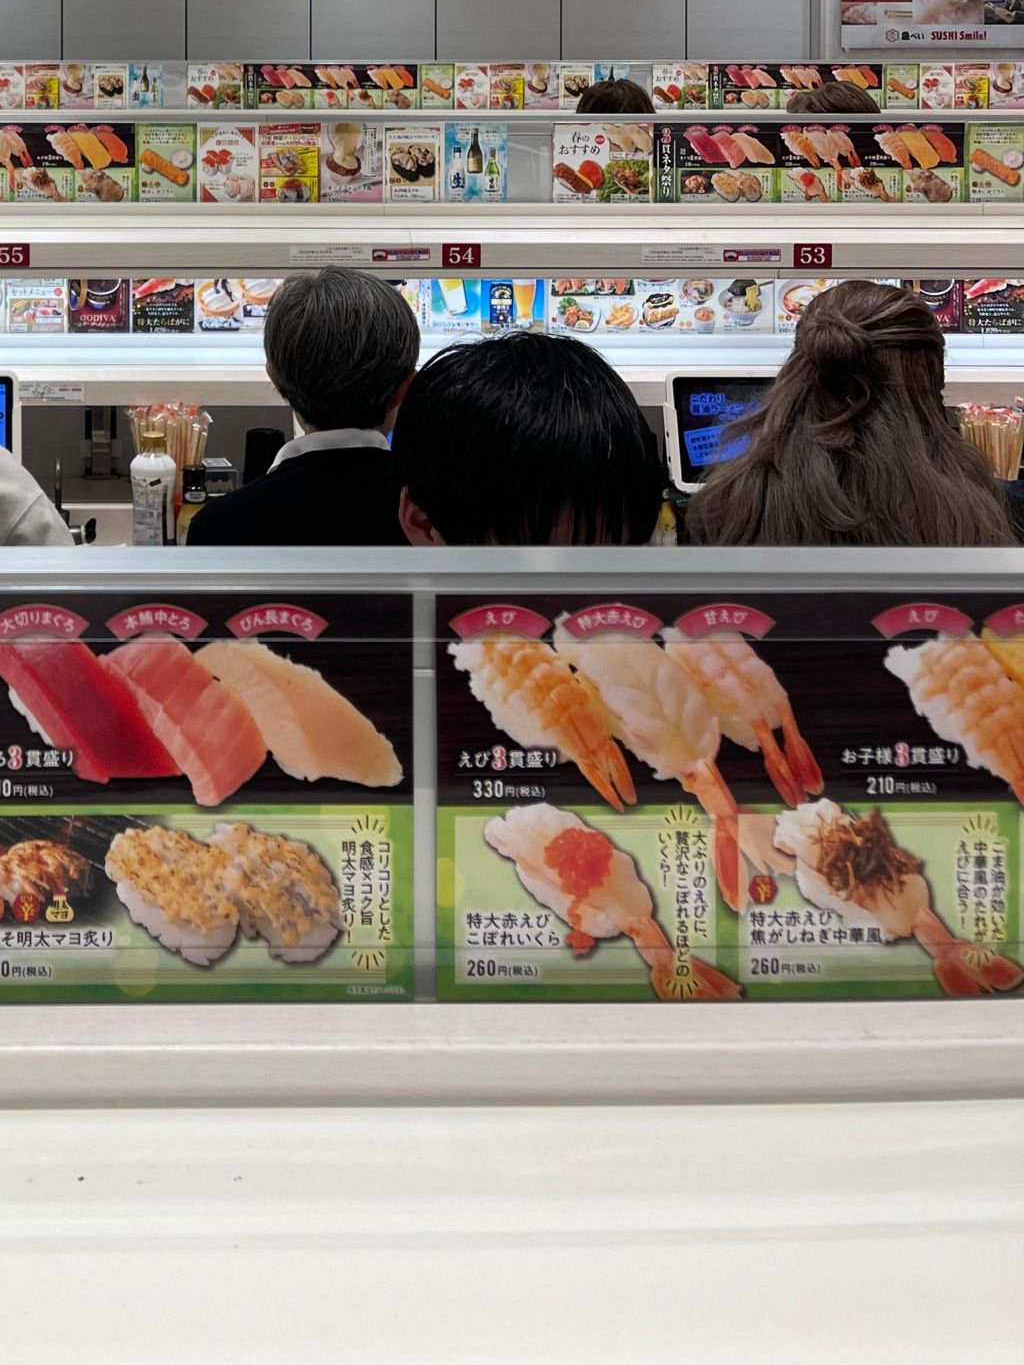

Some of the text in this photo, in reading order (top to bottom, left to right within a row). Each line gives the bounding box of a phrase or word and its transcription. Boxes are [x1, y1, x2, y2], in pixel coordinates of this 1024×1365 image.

[901, 32, 925, 41] 魚べい
[930, 31, 987, 41] SUSHI Smile!
[558, 144, 600, 156] おすすめ
[451, 172, 464, 190] 生
[448, 247, 475, 264] 54
[800, 247, 825, 264] 53
[11, 288, 53, 297] セットメニュー
[79, 314, 116, 323] GODIVA
[690, 394, 725, 404] こだわり
[0, 610, 74, 634] 大切りまぐろ
[123, 610, 191, 631] 本鮪中とろ
[239, 610, 313, 632] びん長まぐろ
[485, 610, 516, 625] えび
[577, 610, 649, 631] 特大赤えび
[704, 610, 748, 625] 甘えび
[908, 609, 940, 623] えび
[458, 745, 557, 771] えび3貫盛り
[841, 742, 960, 767] お子様3貫盛り
[473, 780, 546, 798] 330円(税込)
[866, 776, 937, 794] 210円(税込)
[658, 832, 672, 887] いくら!
[360, 840, 375, 926] 食感×コク旨
[378, 842, 391, 941] コリコリとした
[692, 830, 708, 939] 大ぶりのえびに、
[974, 839, 988, 943] 中華風のたれが
[341, 841, 357, 944] 明太マヨ炙り!
[675, 830, 690, 977] 贅沢なこぼれるほどの
[466, 912, 551, 929] 特大赤えび
[750, 910, 833, 927] 特大赤えび
[467, 931, 560, 946] こぼれいくら
[750, 927, 882, 945] 焦がしねぎ中華風
[467, 959, 538, 977] 260円(税込)
[750, 958, 821, 975] 260円(税込)
